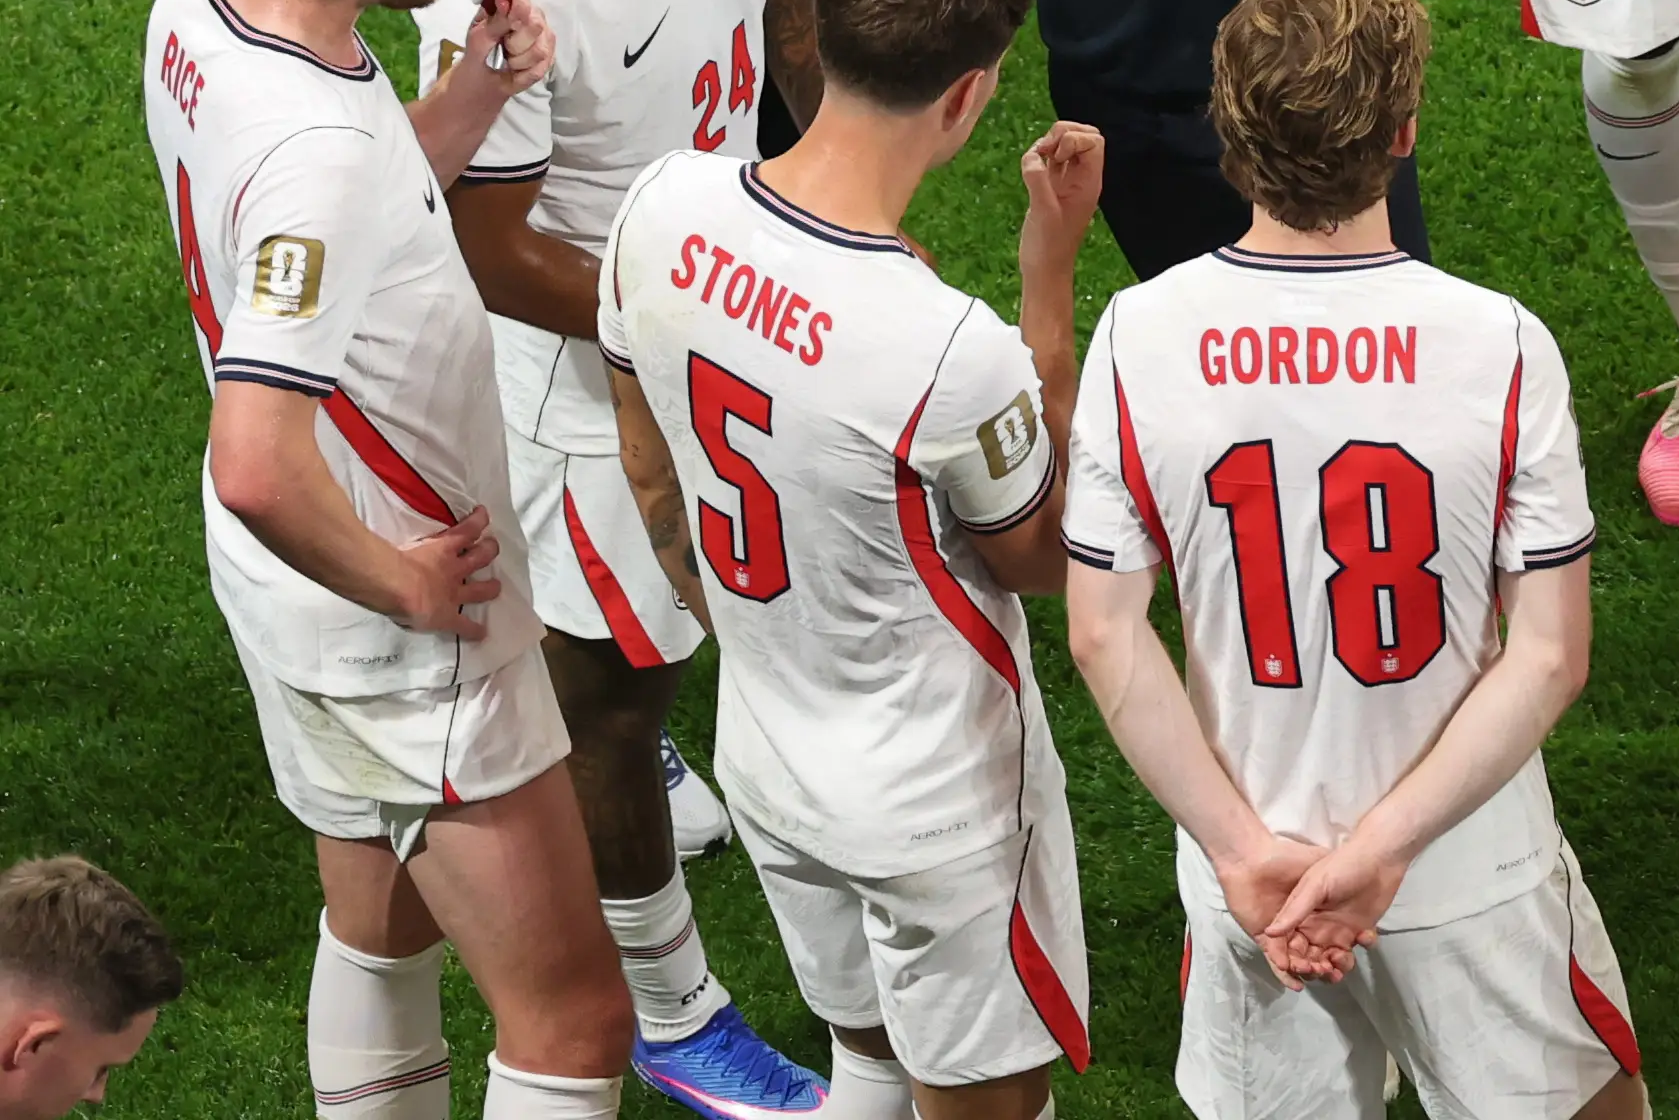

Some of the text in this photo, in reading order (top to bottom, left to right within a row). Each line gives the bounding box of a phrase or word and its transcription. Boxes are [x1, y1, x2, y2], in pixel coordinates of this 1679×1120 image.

[159, 29, 206, 135] RICE
[692, 18, 757, 153] 24
[671, 234, 832, 366] STONES
[1199, 326, 1417, 385] GORDON
[688, 349, 792, 604] 5
[1205, 439, 1447, 688] 18
